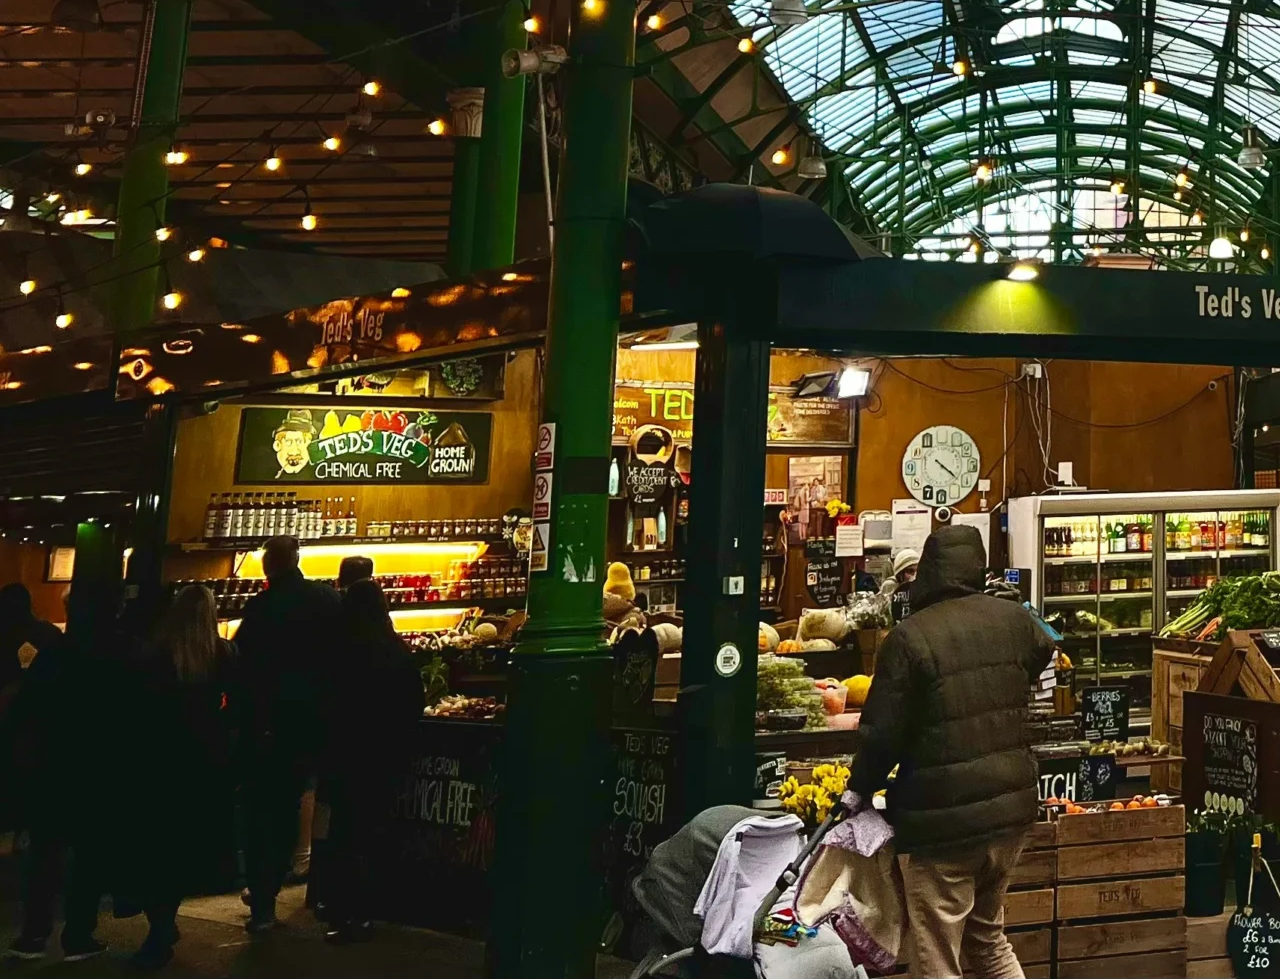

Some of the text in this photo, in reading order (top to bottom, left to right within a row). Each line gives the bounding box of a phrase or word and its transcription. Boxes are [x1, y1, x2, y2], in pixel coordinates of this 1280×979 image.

[1195, 285, 1252, 318] Ted's
[320, 307, 385, 346] Ted's Veg
[318, 431, 417, 459] TED'S VEG
[435, 446, 466, 458] HOME
[315, 461, 403, 479] CHEMICAL FREE
[431, 458, 471, 474] GROWN
[613, 776, 666, 824] SQUASH
[1234, 912, 1263, 929] FLOWER
[1242, 928, 1259, 943] £6
[1243, 944, 1250, 953] 2
[1247, 954, 1270, 968] £10
